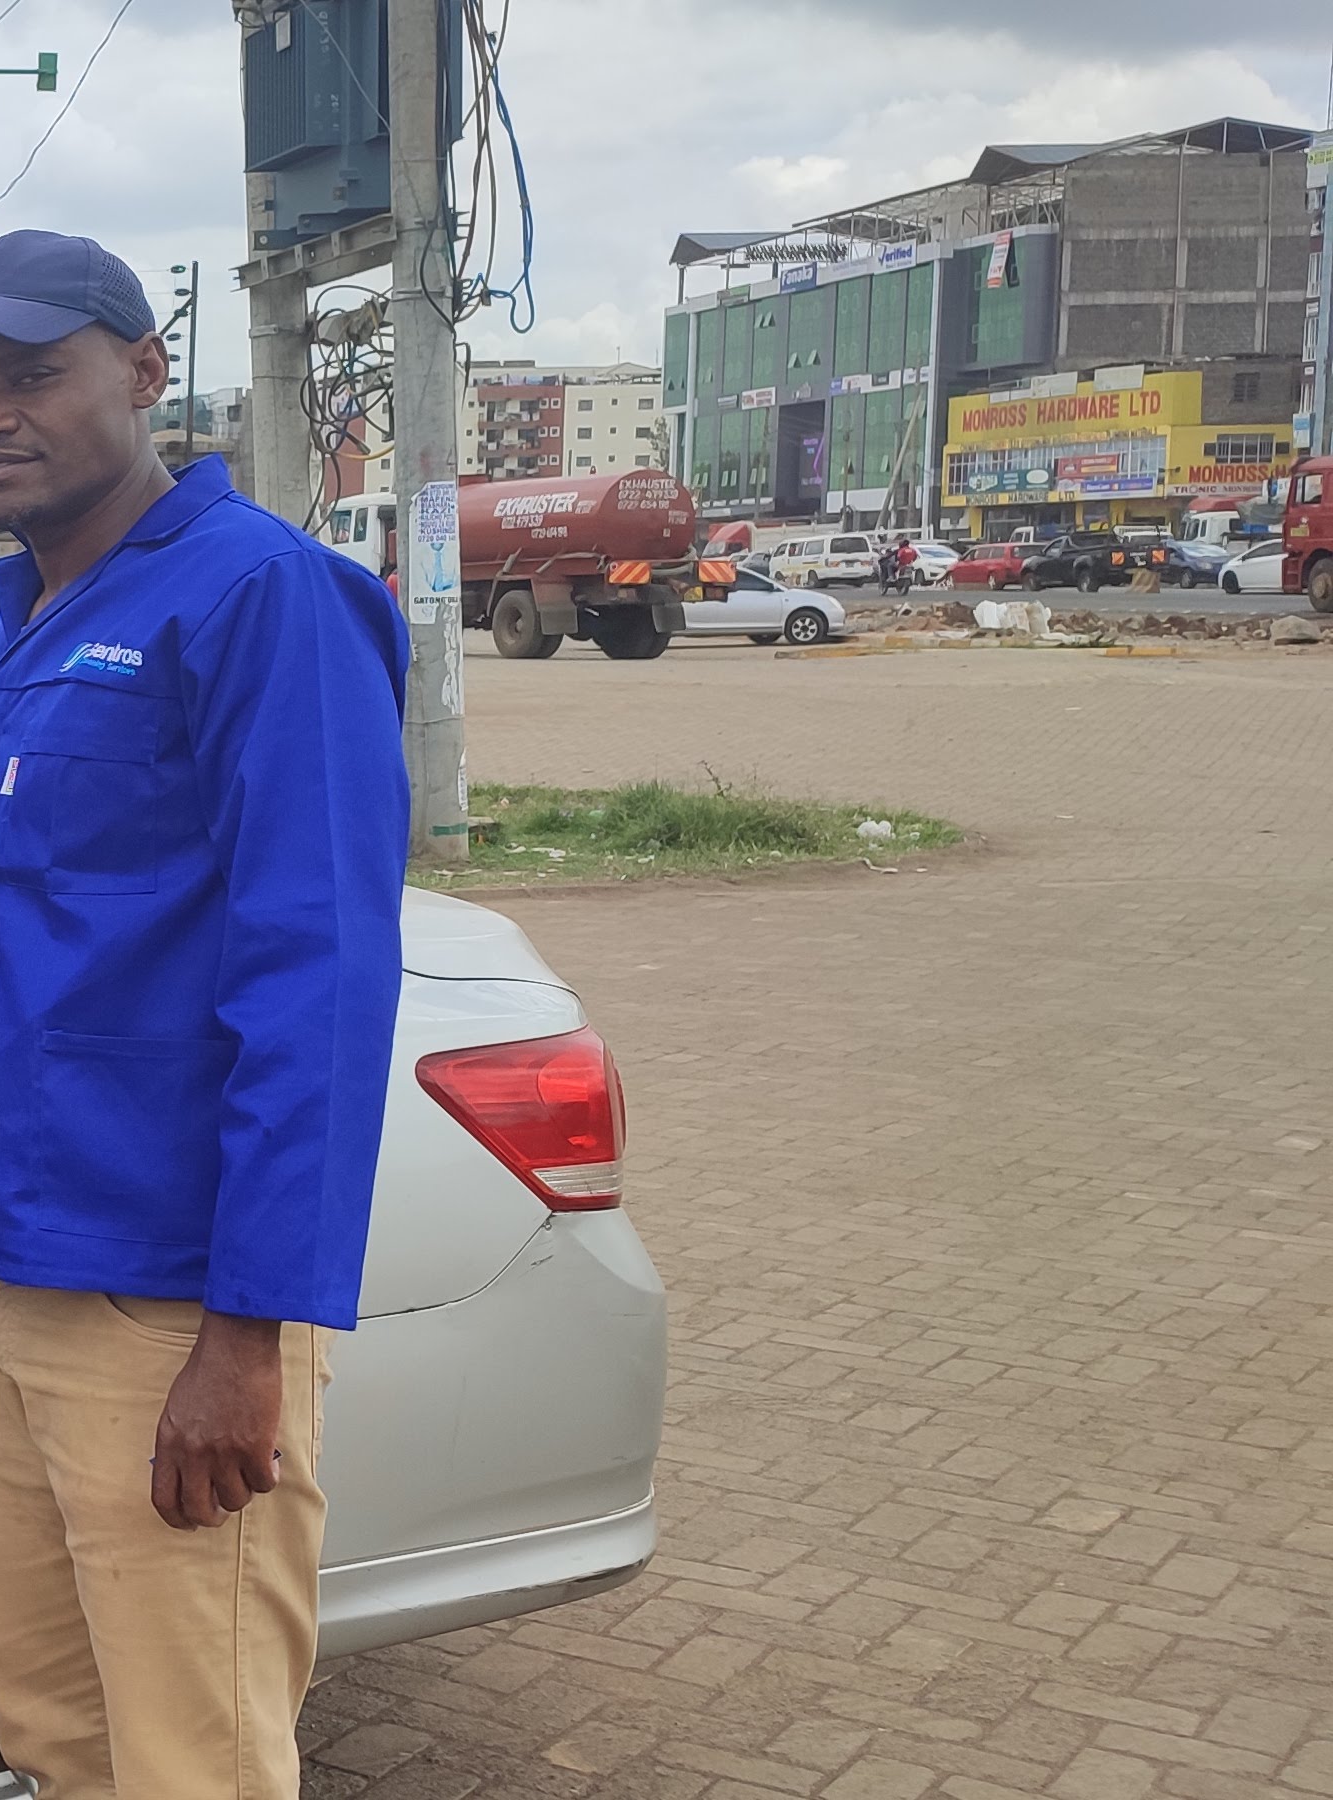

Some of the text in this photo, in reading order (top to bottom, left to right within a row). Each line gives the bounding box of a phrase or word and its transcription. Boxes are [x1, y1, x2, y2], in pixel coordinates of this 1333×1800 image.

[962, 389, 1162, 433] MONROSS HARDWARE LTD
[619, 478, 677, 490] EXHAUSTER
[1188, 463, 1269, 484] MONROSS
[493, 491, 579, 517] EXHAUSTER
